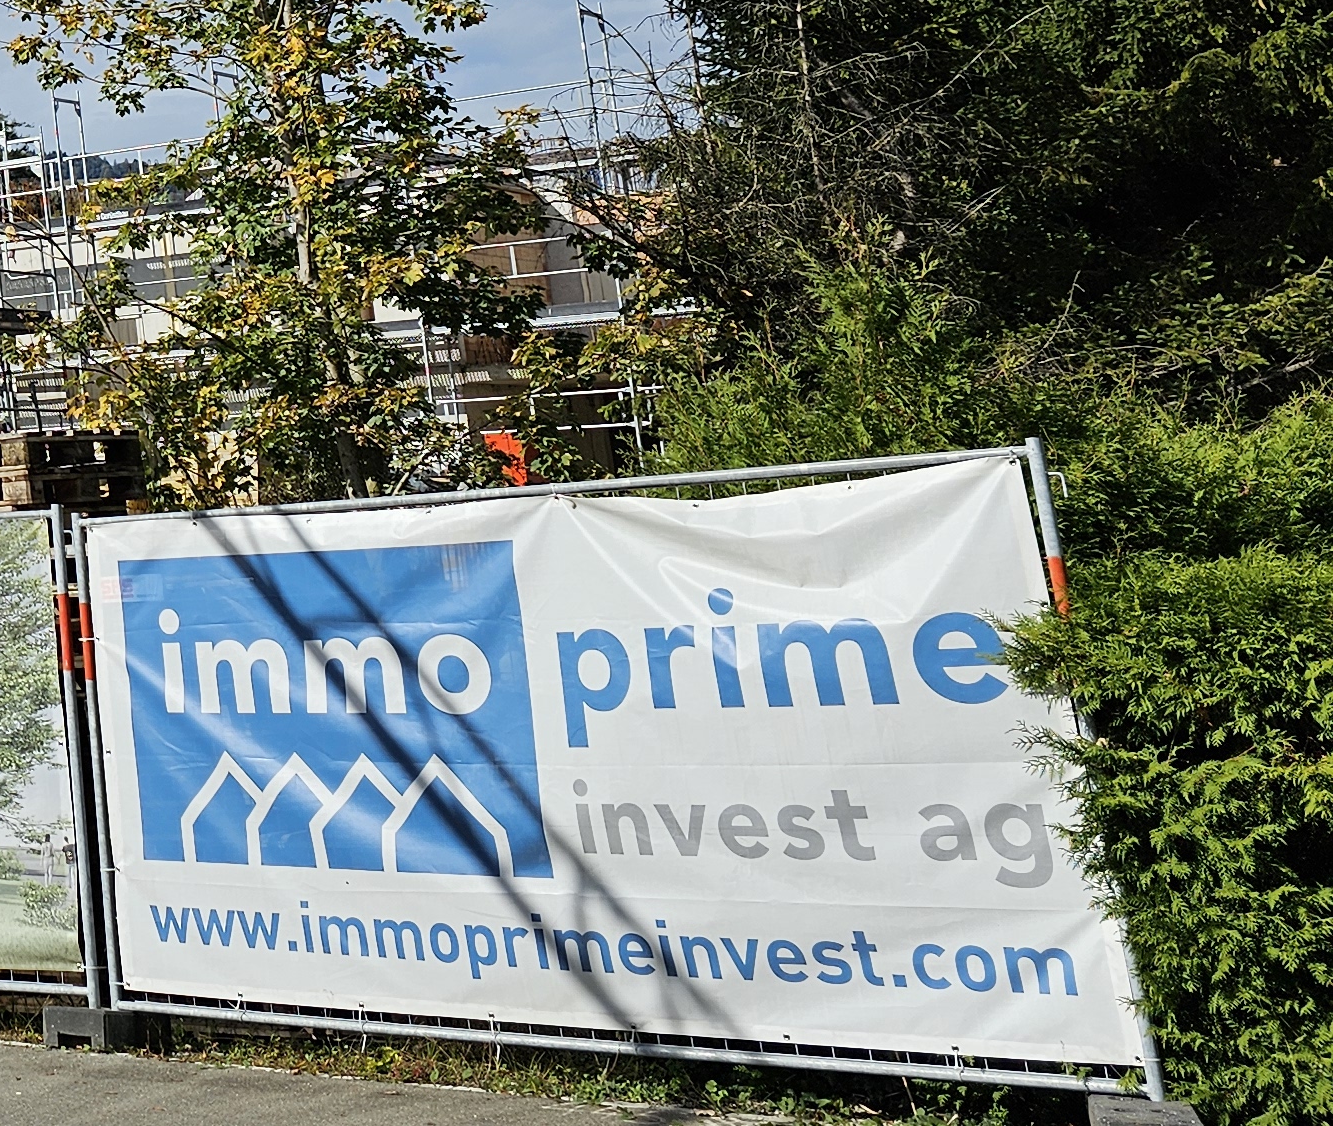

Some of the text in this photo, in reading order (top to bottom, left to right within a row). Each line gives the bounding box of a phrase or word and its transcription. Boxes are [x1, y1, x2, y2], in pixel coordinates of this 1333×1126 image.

[157, 607, 492, 716] immo
[556, 588, 1009, 748] prime
[575, 779, 1054, 889] invest ag
[150, 901, 1079, 997] www.immoprimeinvest.com
